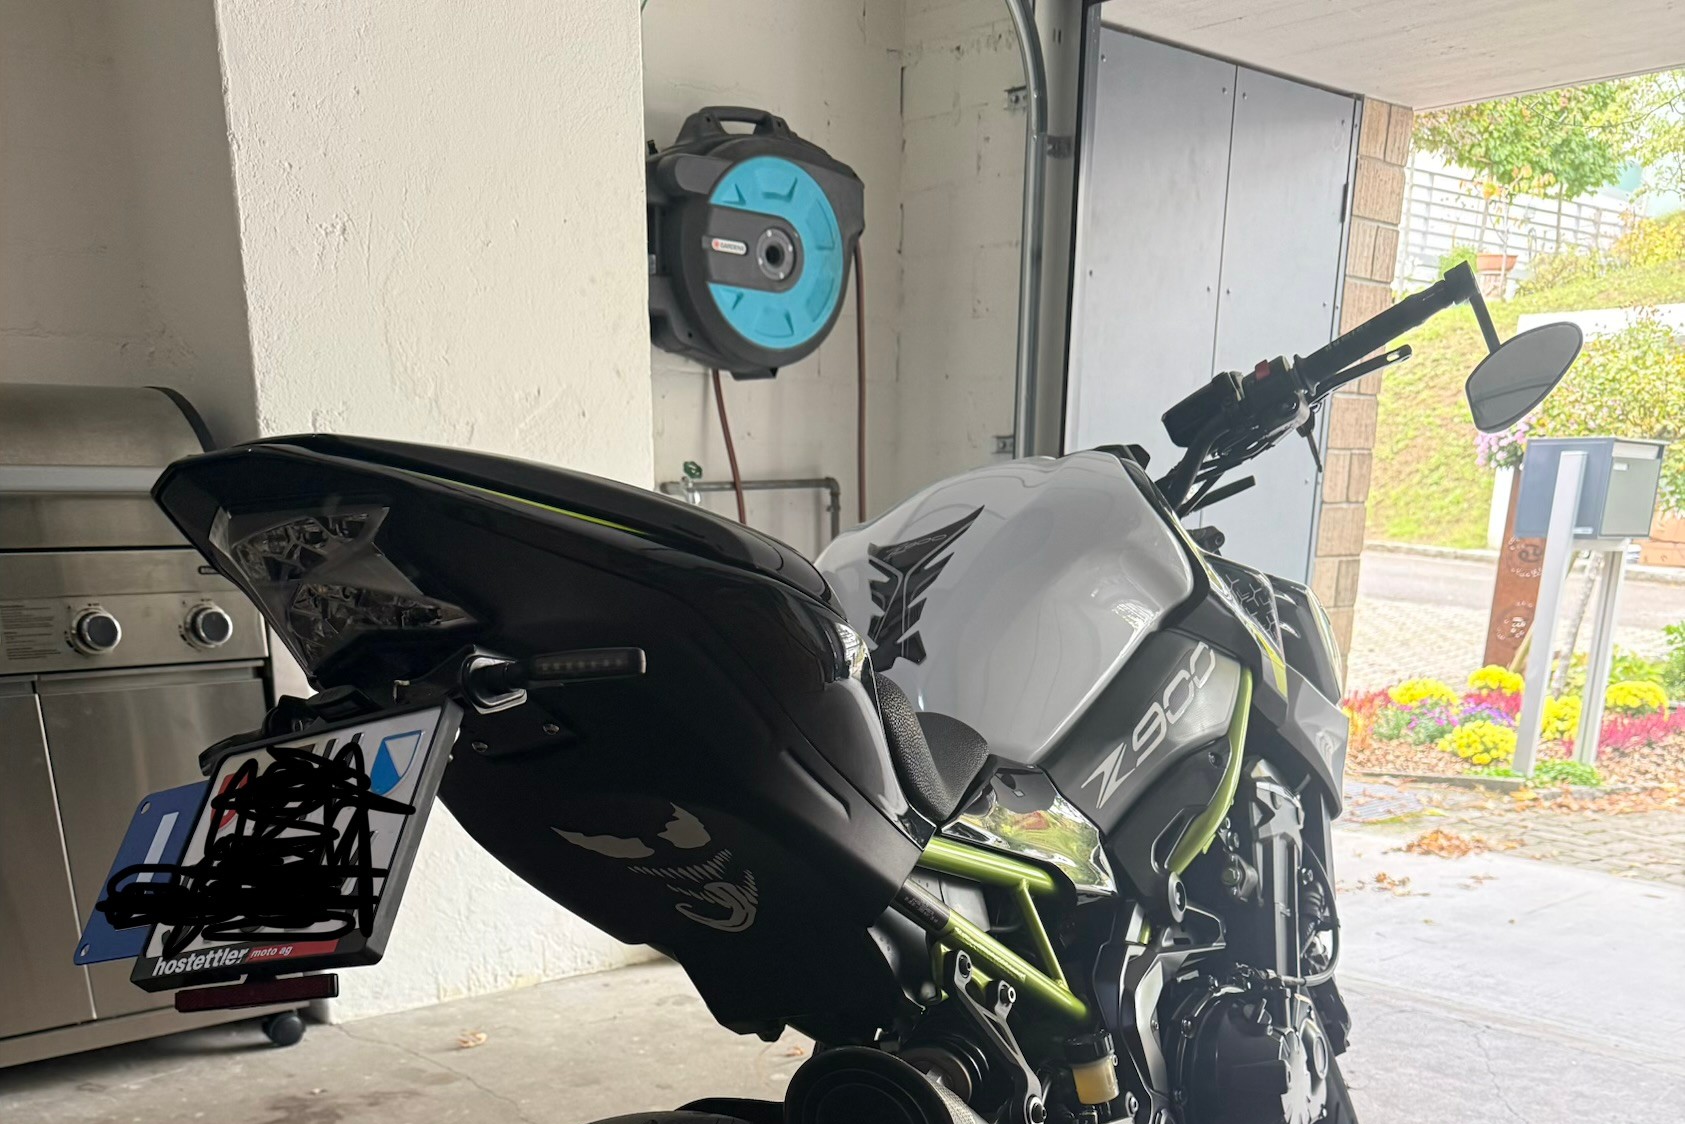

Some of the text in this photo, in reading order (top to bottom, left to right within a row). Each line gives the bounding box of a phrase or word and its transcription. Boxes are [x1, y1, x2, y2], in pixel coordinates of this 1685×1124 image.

[1081, 641, 1216, 809] Z900
[152, 945, 293, 976] hostettler moto ag
